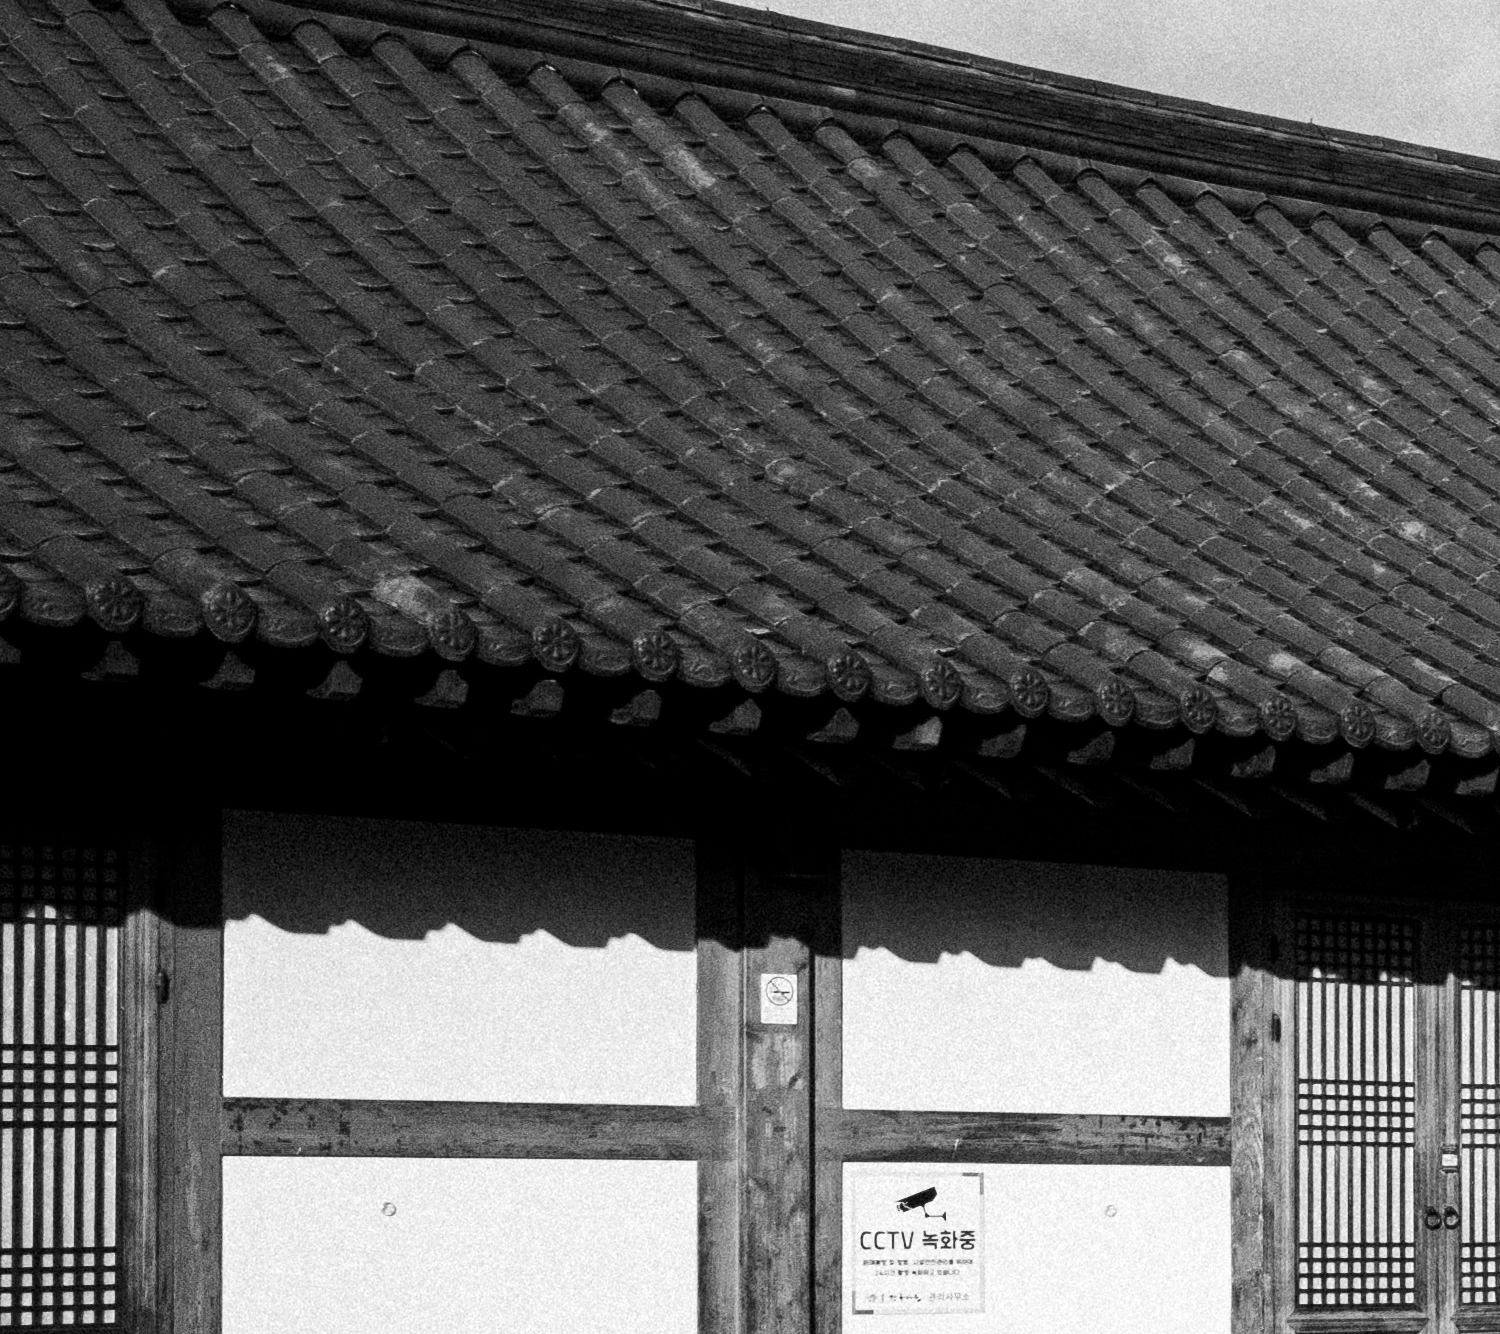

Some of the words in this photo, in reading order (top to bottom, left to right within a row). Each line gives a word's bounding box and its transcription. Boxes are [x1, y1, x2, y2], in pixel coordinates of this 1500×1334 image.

[860, 1231, 914, 1250] CCTV
[922, 1230, 976, 1250] 녹화중
[928, 1292, 970, 1301] 관리사무소
